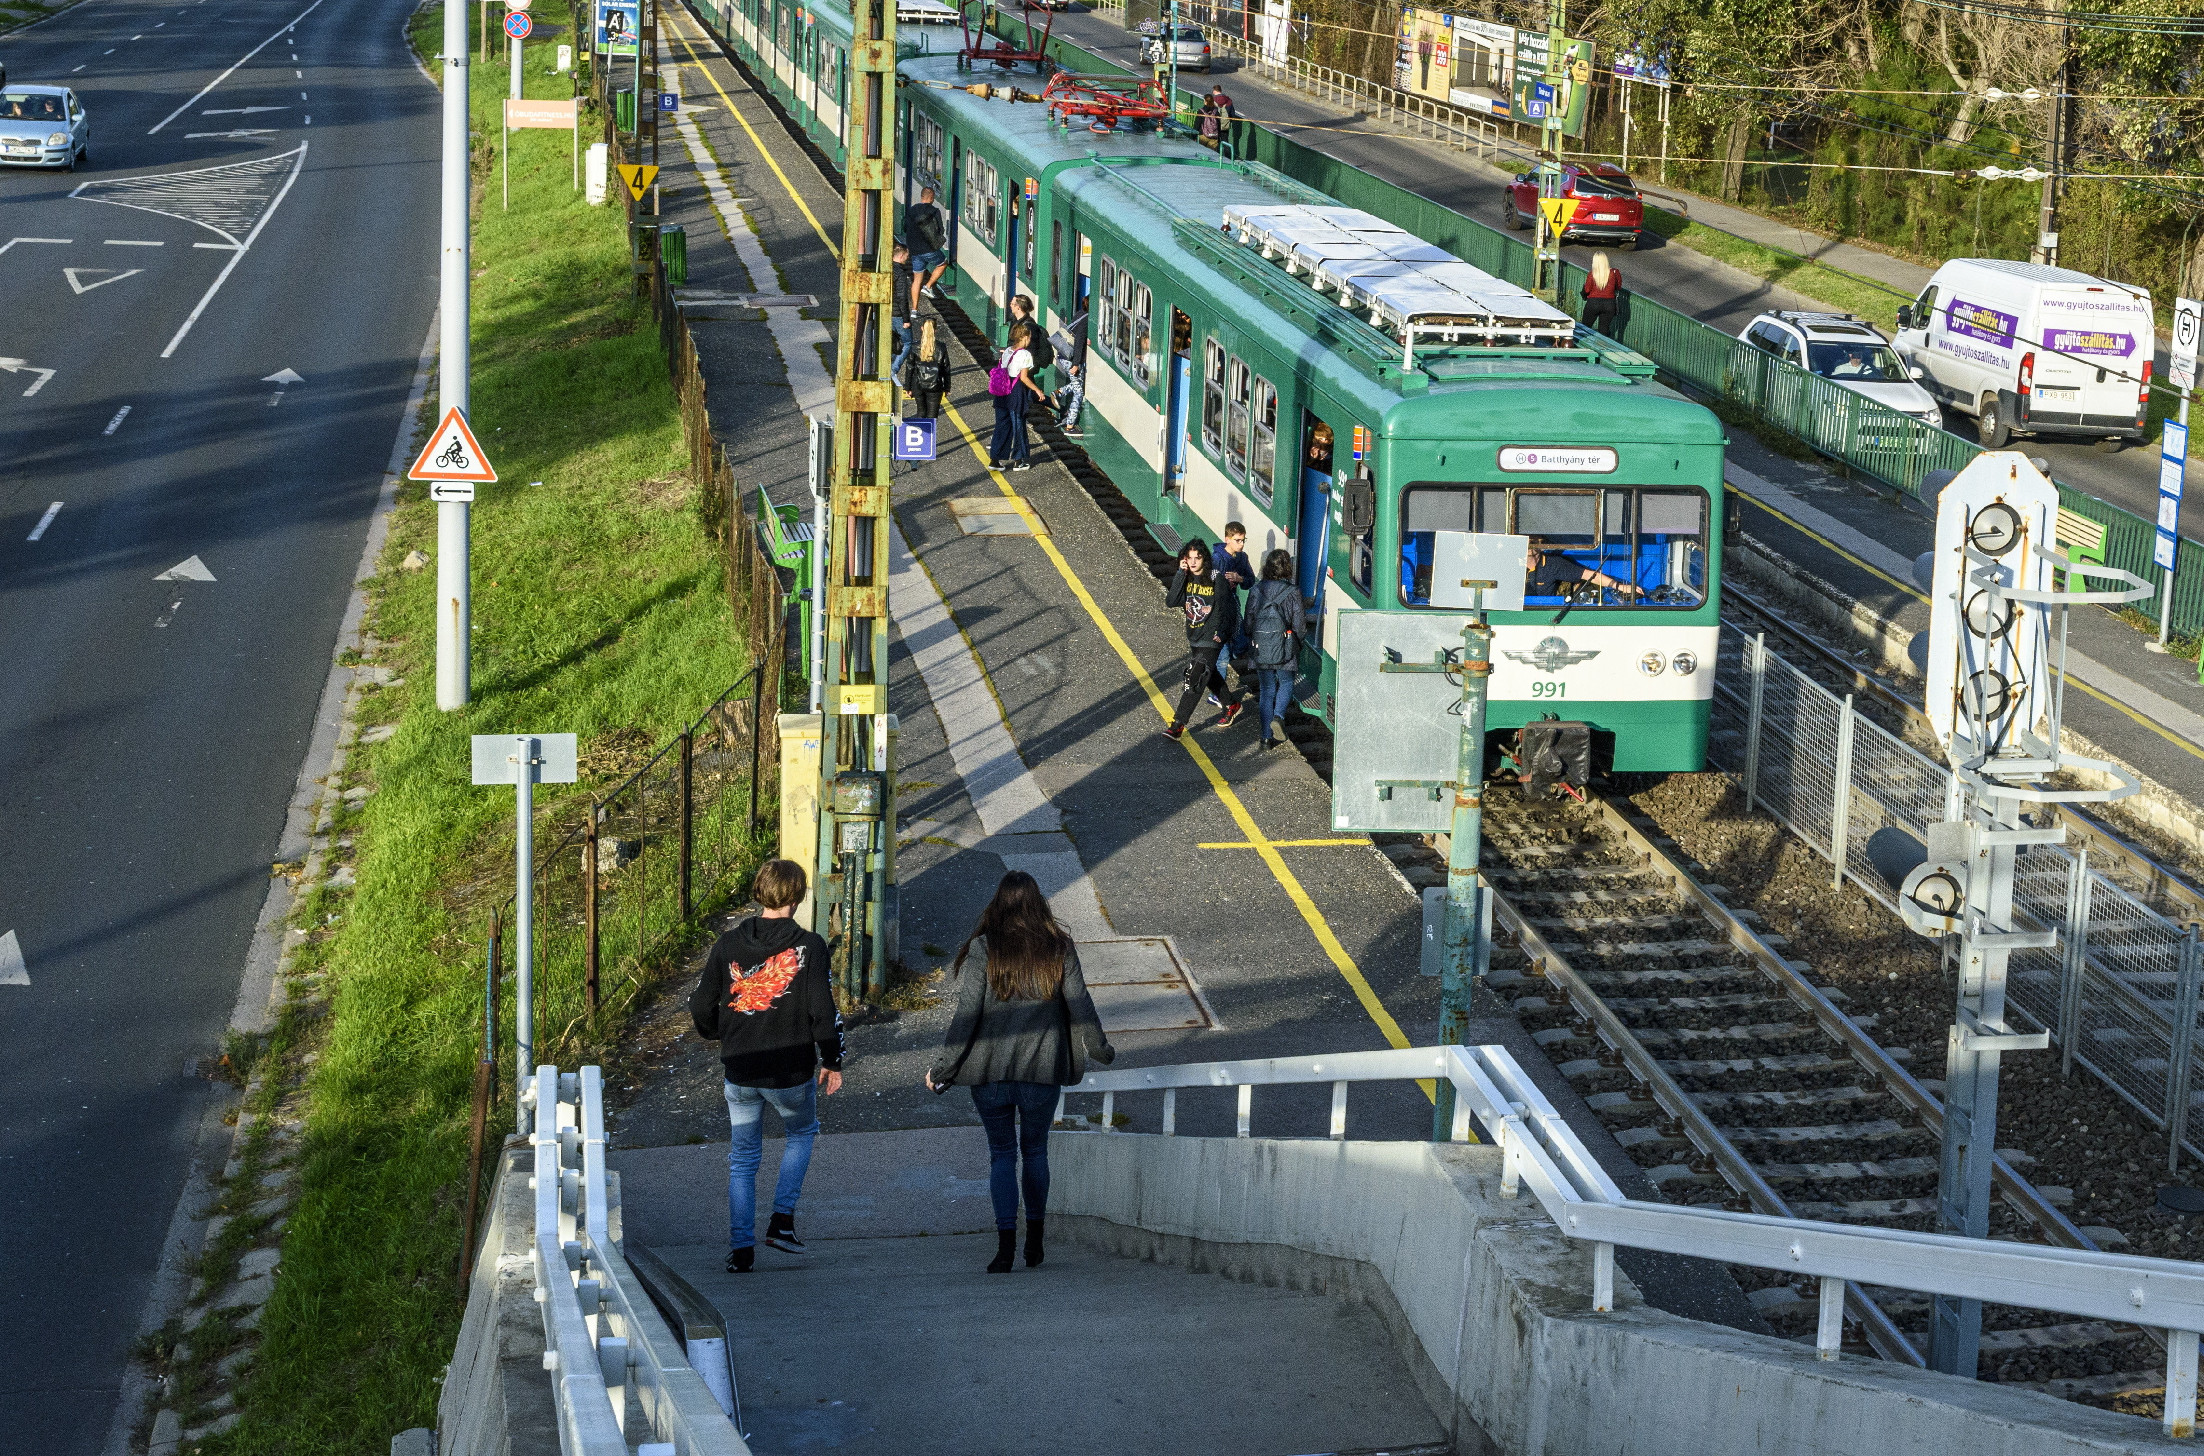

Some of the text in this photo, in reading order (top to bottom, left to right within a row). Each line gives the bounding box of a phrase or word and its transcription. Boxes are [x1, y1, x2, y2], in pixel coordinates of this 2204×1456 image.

[664, 96, 672, 106] B
[1533, 103, 1540, 112] A
[632, 167, 644, 191] 4
[1553, 203, 1563, 227] 4
[2043, 300, 2144, 312] www.gyujtoszallitas.hu
[1939, 339, 2010, 369] www.gyujtoszallitas.hu
[906, 426, 924, 446] B
[1541, 456, 1585, 465] Batthyány
[1532, 682, 1565, 697] 991
